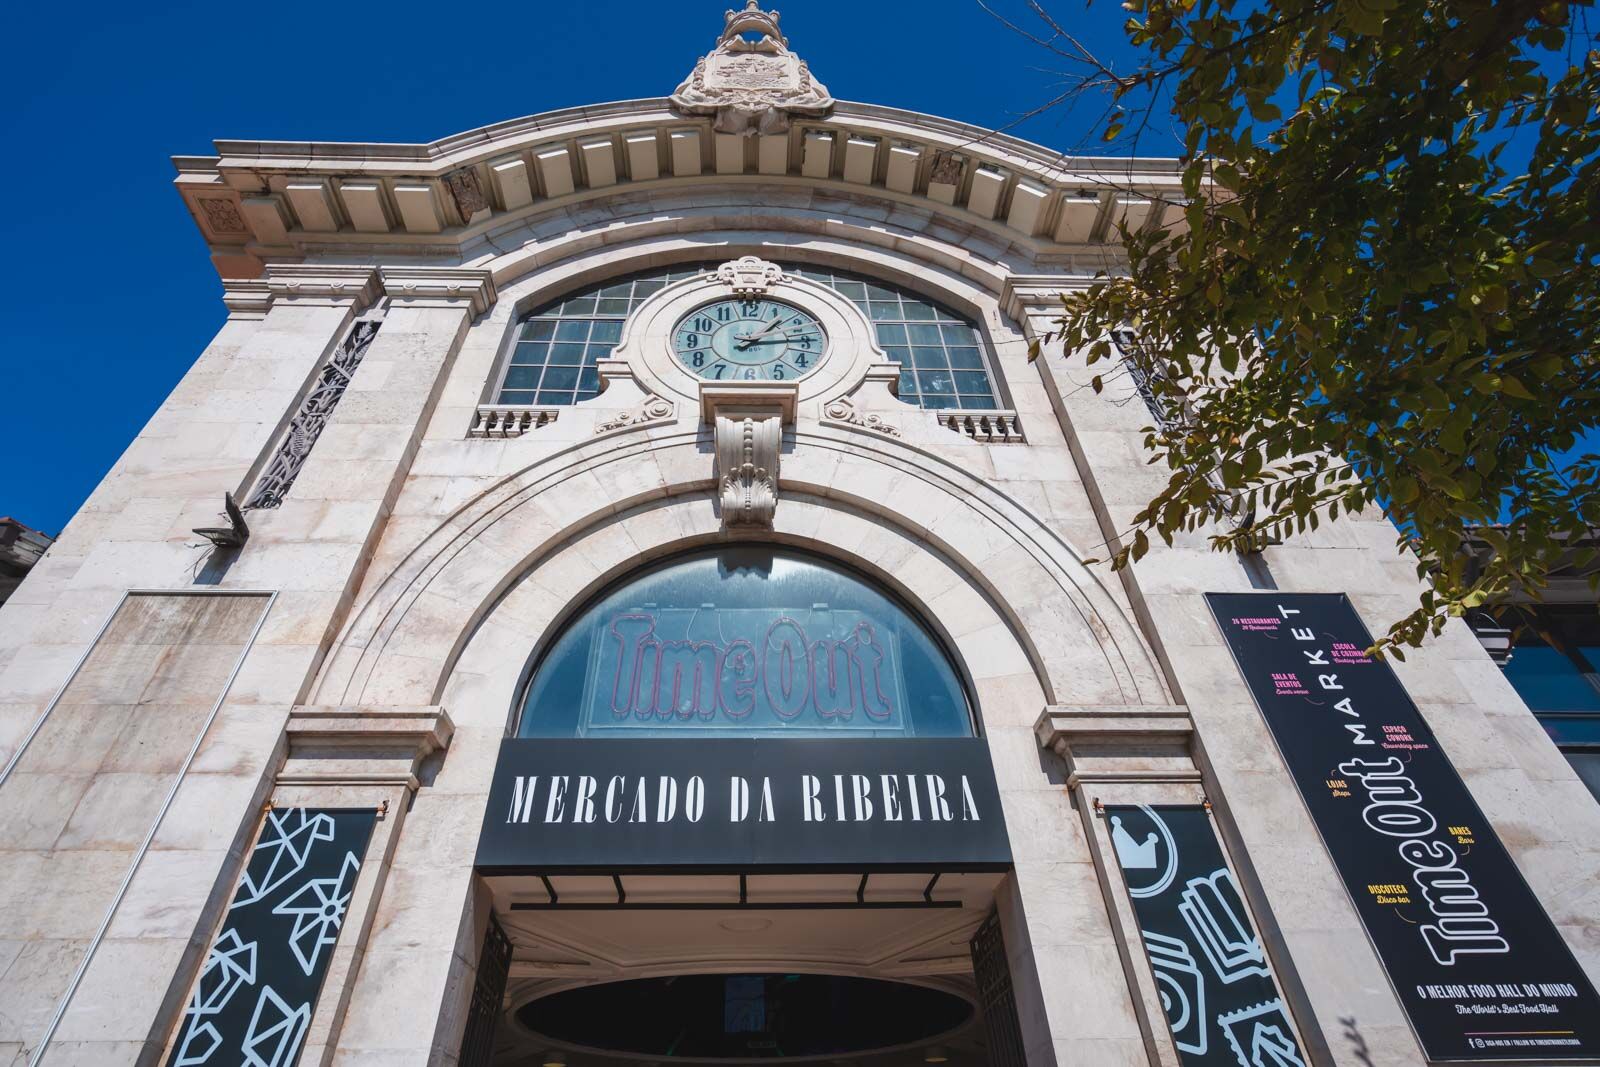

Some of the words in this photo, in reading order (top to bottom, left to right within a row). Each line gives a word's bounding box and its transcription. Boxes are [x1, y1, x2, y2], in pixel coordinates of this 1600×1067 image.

[717, 307, 730, 321] 11
[742, 304, 759, 318] 12
[694, 318, 713, 333] 10
[687, 334, 698, 348] 9
[692, 352, 705, 367] 8
[795, 352, 809, 368] 4
[714, 364, 727, 380] 7
[773, 364, 785, 380] 5
[1240, 617, 1281, 625] RESTAURANTES
[1277, 604, 1375, 745] MARKET
[1274, 680, 1302, 688] EVENTOS
[1381, 725, 1407, 734] ESPAÇO
[1385, 734, 1414, 742] COWORK
[1325, 779, 1347, 788] LOJAS
[506, 776, 705, 824] MERCADO
[730, 776, 775, 823] DA
[803, 774, 980, 823] RIBEIRA
[1448, 826, 1472, 835] BARES
[1367, 884, 1408, 894] DISCOTECA
[1376, 895, 1397, 904] Disco
[1416, 985, 1427, 999] O
[1425, 984, 1470, 999] MELHOR
[1466, 984, 1497, 998] FOOD
[1495, 983, 1525, 997] HALL
[1522, 983, 1541, 997] DO
[1538, 983, 1578, 997] MUNDO
[1455, 1004, 1472, 1014] The
[1471, 1004, 1501, 1014] World's
[1501, 1003, 1519, 1014] Best
[1518, 1003, 1540, 1014] Food
[1539, 1003, 1559, 1014] Hall
